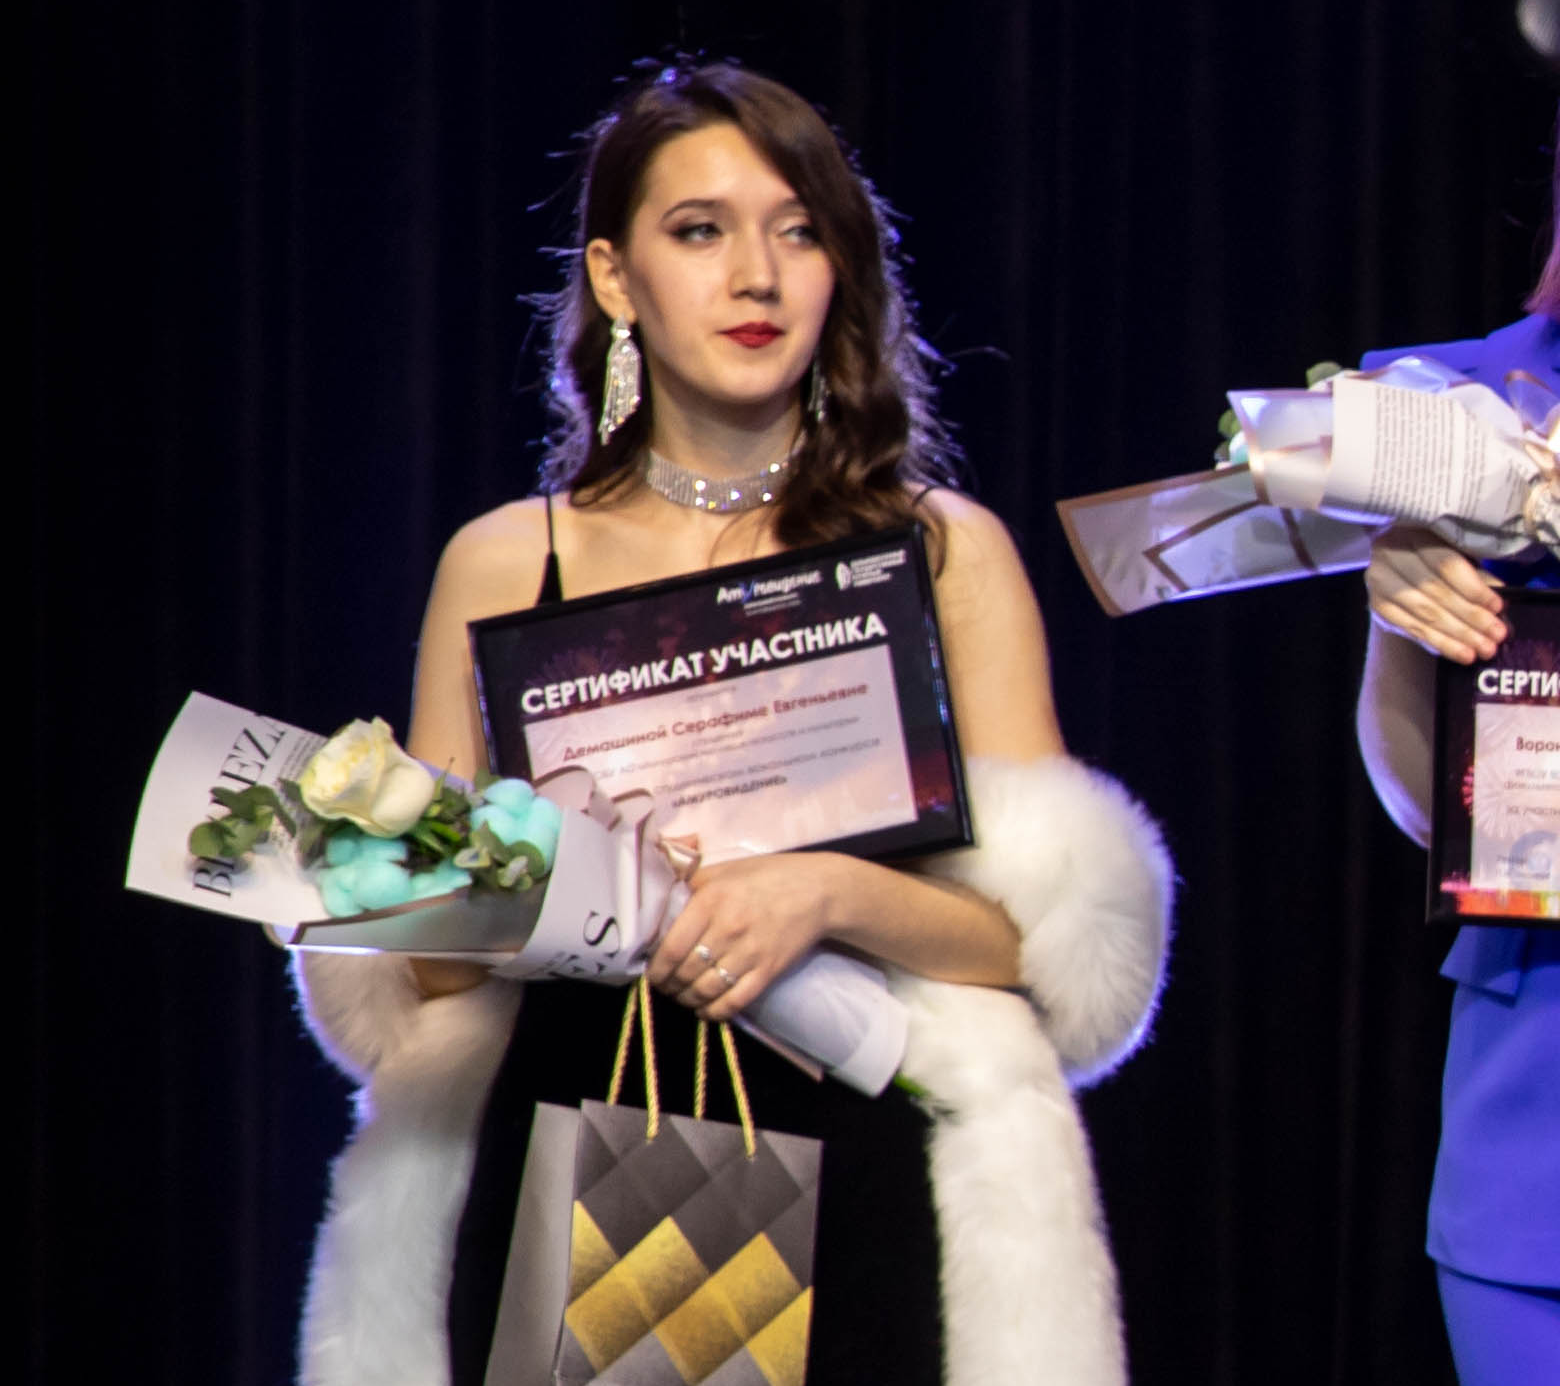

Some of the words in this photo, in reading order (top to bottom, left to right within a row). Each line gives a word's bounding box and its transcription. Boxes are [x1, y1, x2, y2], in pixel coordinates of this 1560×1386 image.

[521, 654, 704, 714] СЕРТИФИКАТ
[709, 612, 889, 674] УЧАСТНИКА
[671, 706, 769, 736] Серафиме
[773, 684, 868, 714] Евгеньевне
